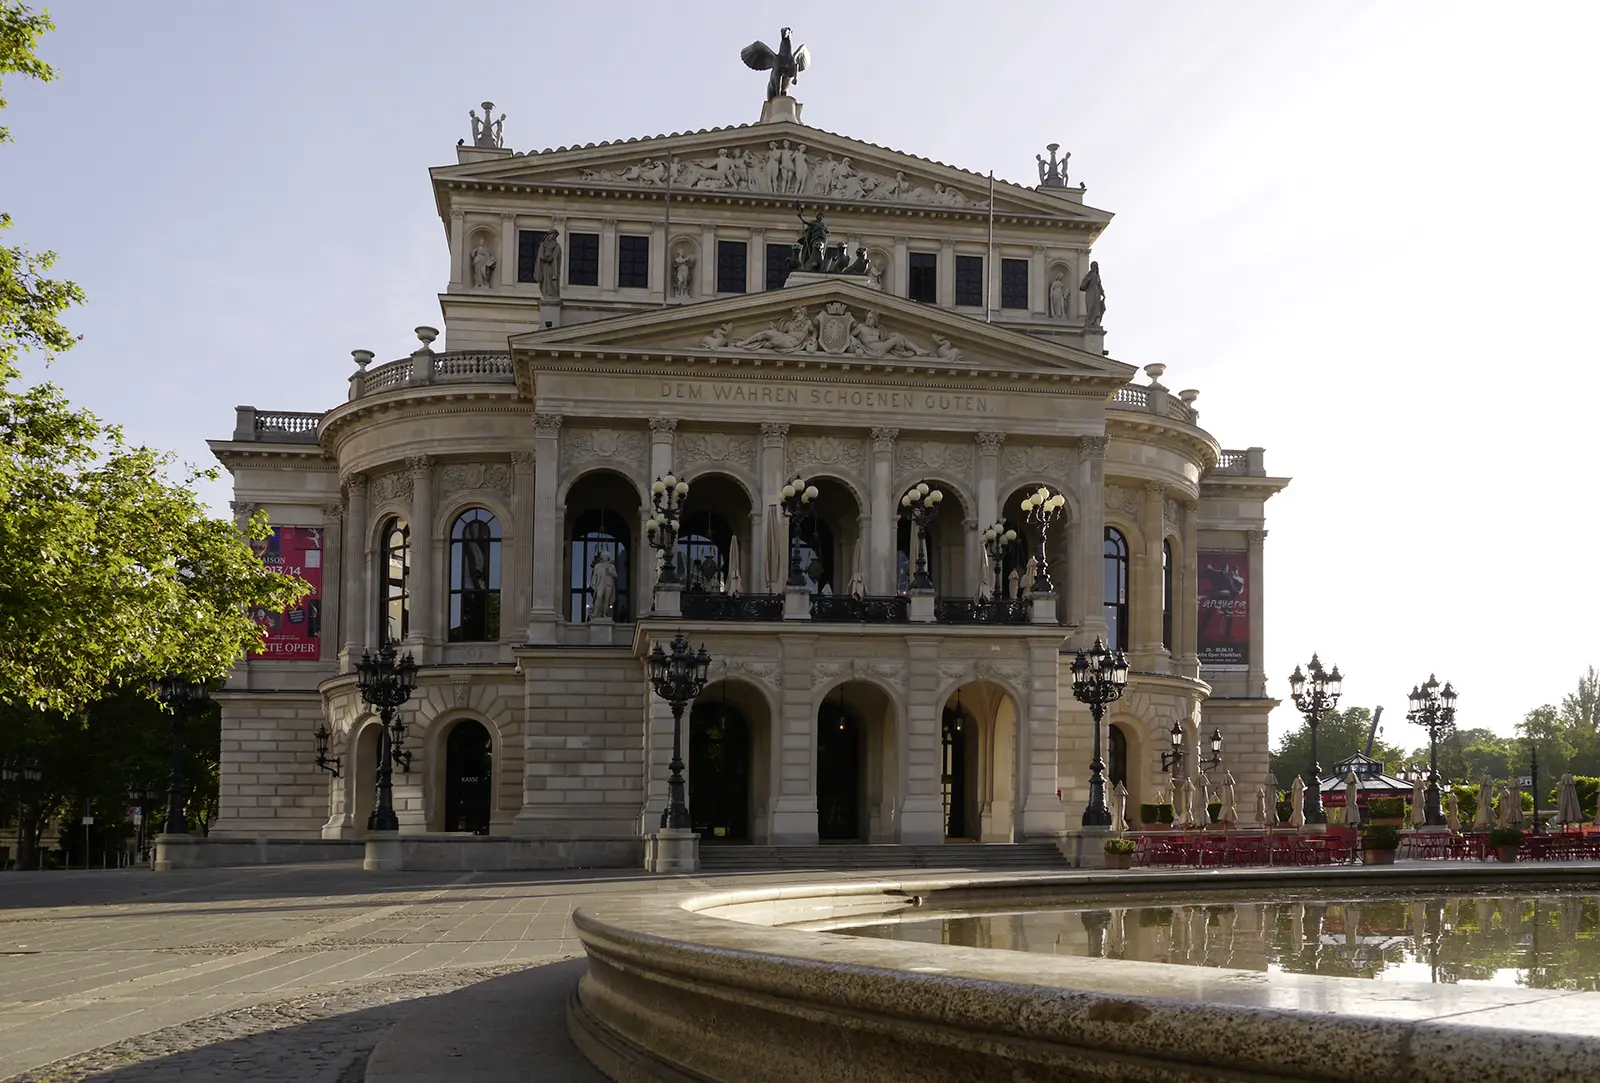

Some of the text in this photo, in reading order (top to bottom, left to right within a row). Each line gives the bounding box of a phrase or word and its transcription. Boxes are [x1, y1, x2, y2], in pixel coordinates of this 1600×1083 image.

[661, 382, 995, 412] DEM WAHREN SCHOENEN GUTEN.
[262, 556, 286, 564] AISON
[264, 565, 301, 576] 013/14
[266, 643, 315, 653] TE OPER
